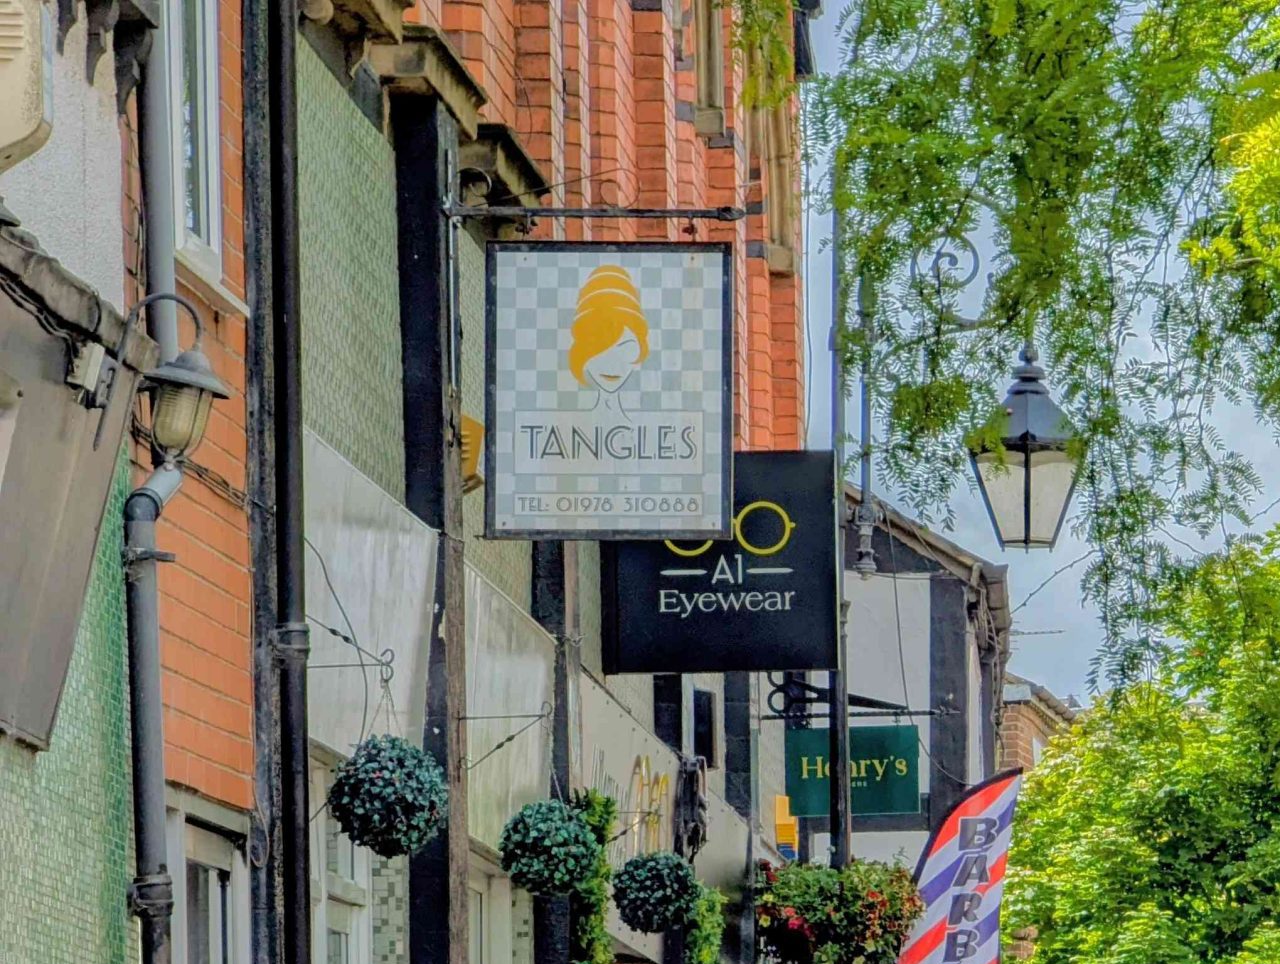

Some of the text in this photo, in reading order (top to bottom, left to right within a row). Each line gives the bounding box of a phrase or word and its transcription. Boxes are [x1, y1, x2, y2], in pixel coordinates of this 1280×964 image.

[520, 425, 698, 460] TANGLES
[518, 496, 700, 512] TEL: 01978 310888
[659, 589, 796, 619] Eyewear
